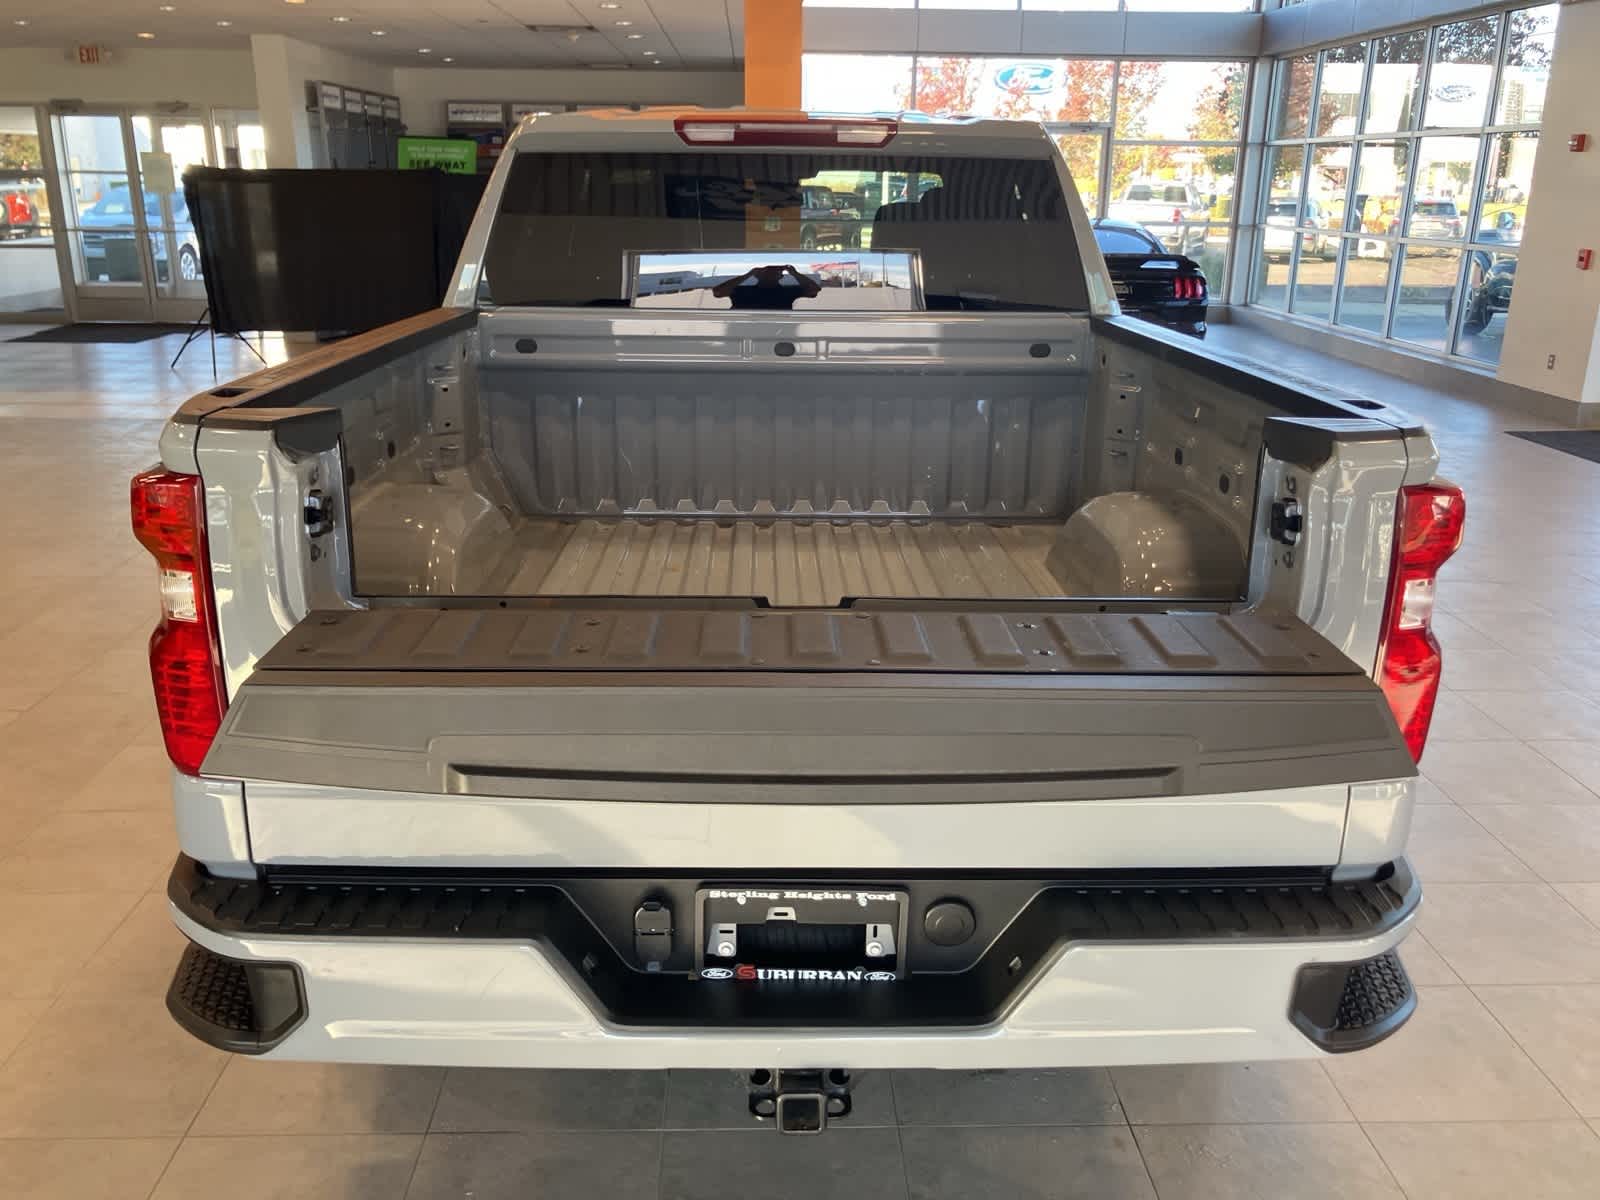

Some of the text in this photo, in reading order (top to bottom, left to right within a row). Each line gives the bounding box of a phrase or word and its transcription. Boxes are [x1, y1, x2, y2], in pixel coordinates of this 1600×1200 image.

[79, 46, 99, 64] EXIT
[708, 890, 897, 902] Sterling Heights Ford
